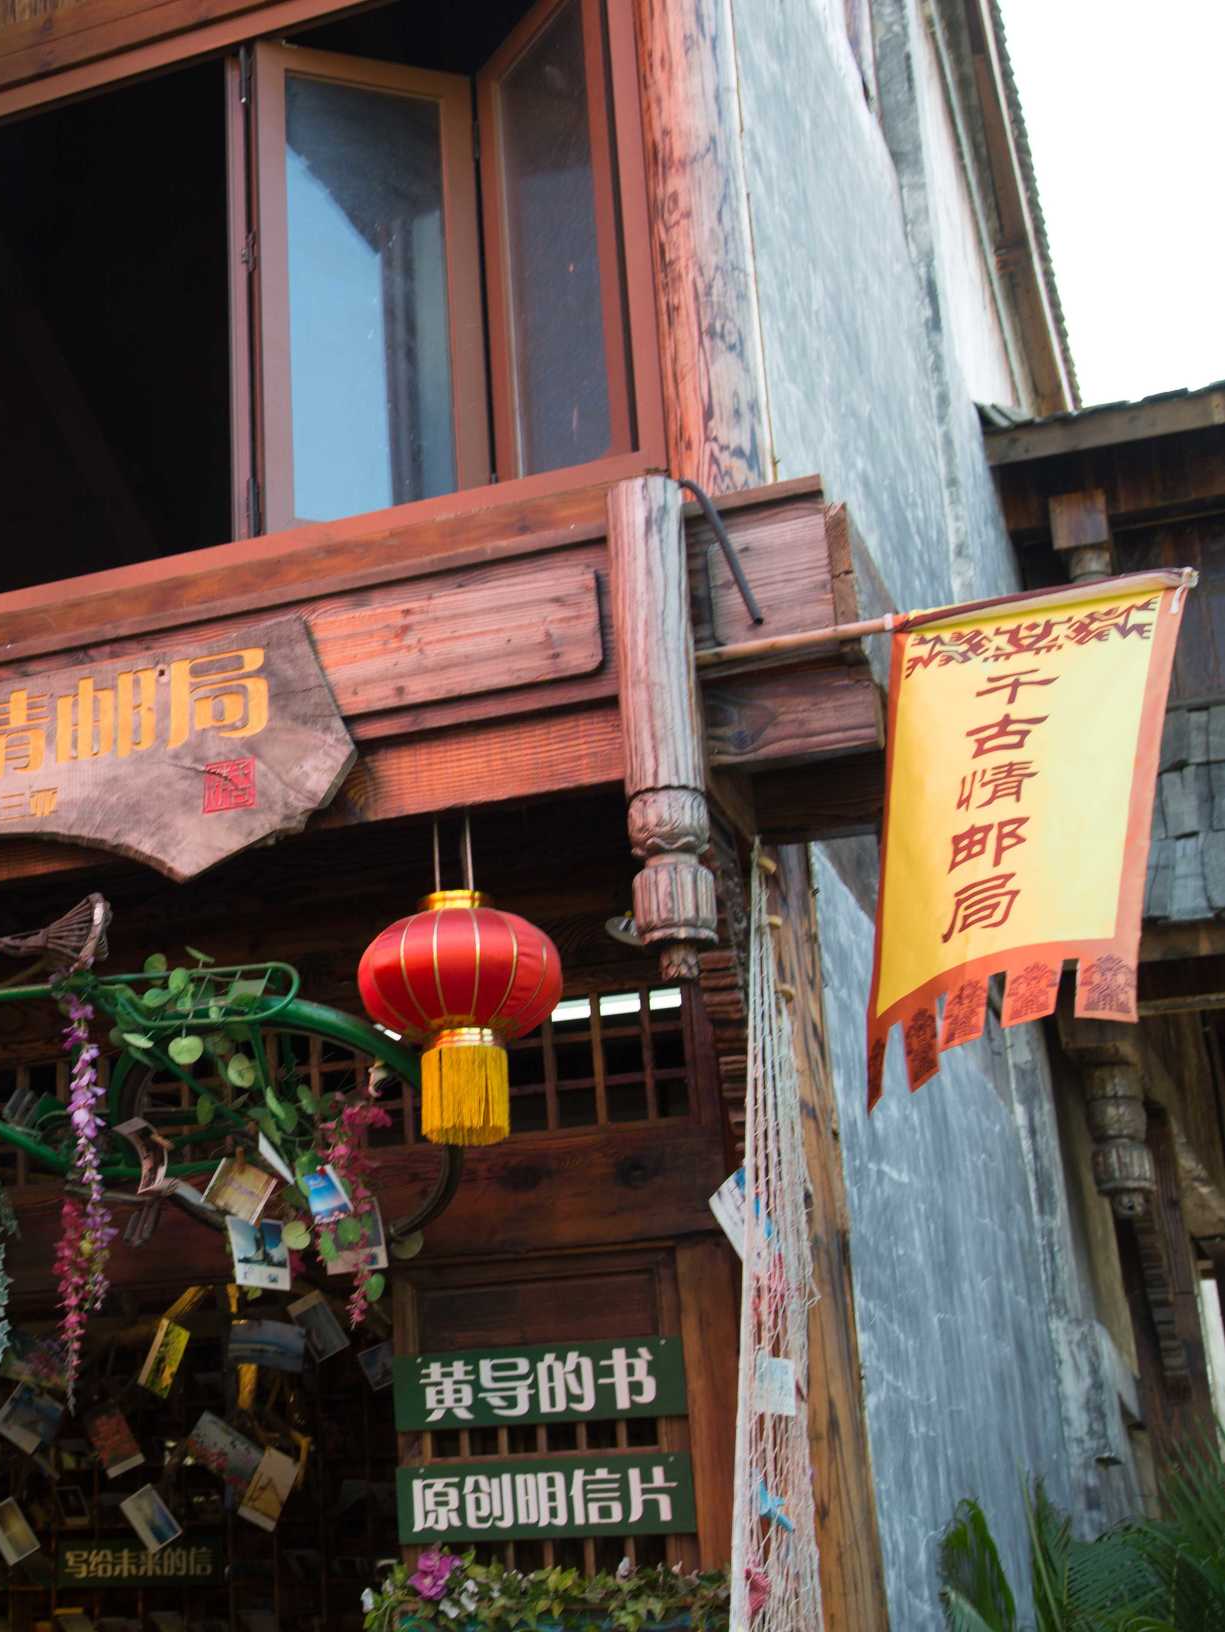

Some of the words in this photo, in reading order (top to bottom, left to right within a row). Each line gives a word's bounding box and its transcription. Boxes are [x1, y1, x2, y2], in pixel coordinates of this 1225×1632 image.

[942, 668, 1059, 943] 千古情邮局
[419, 1347, 657, 1423] 黄导的书
[412, 1465, 677, 1532] 原创明信片
[64, 1546, 214, 1578] 写给未来的信
